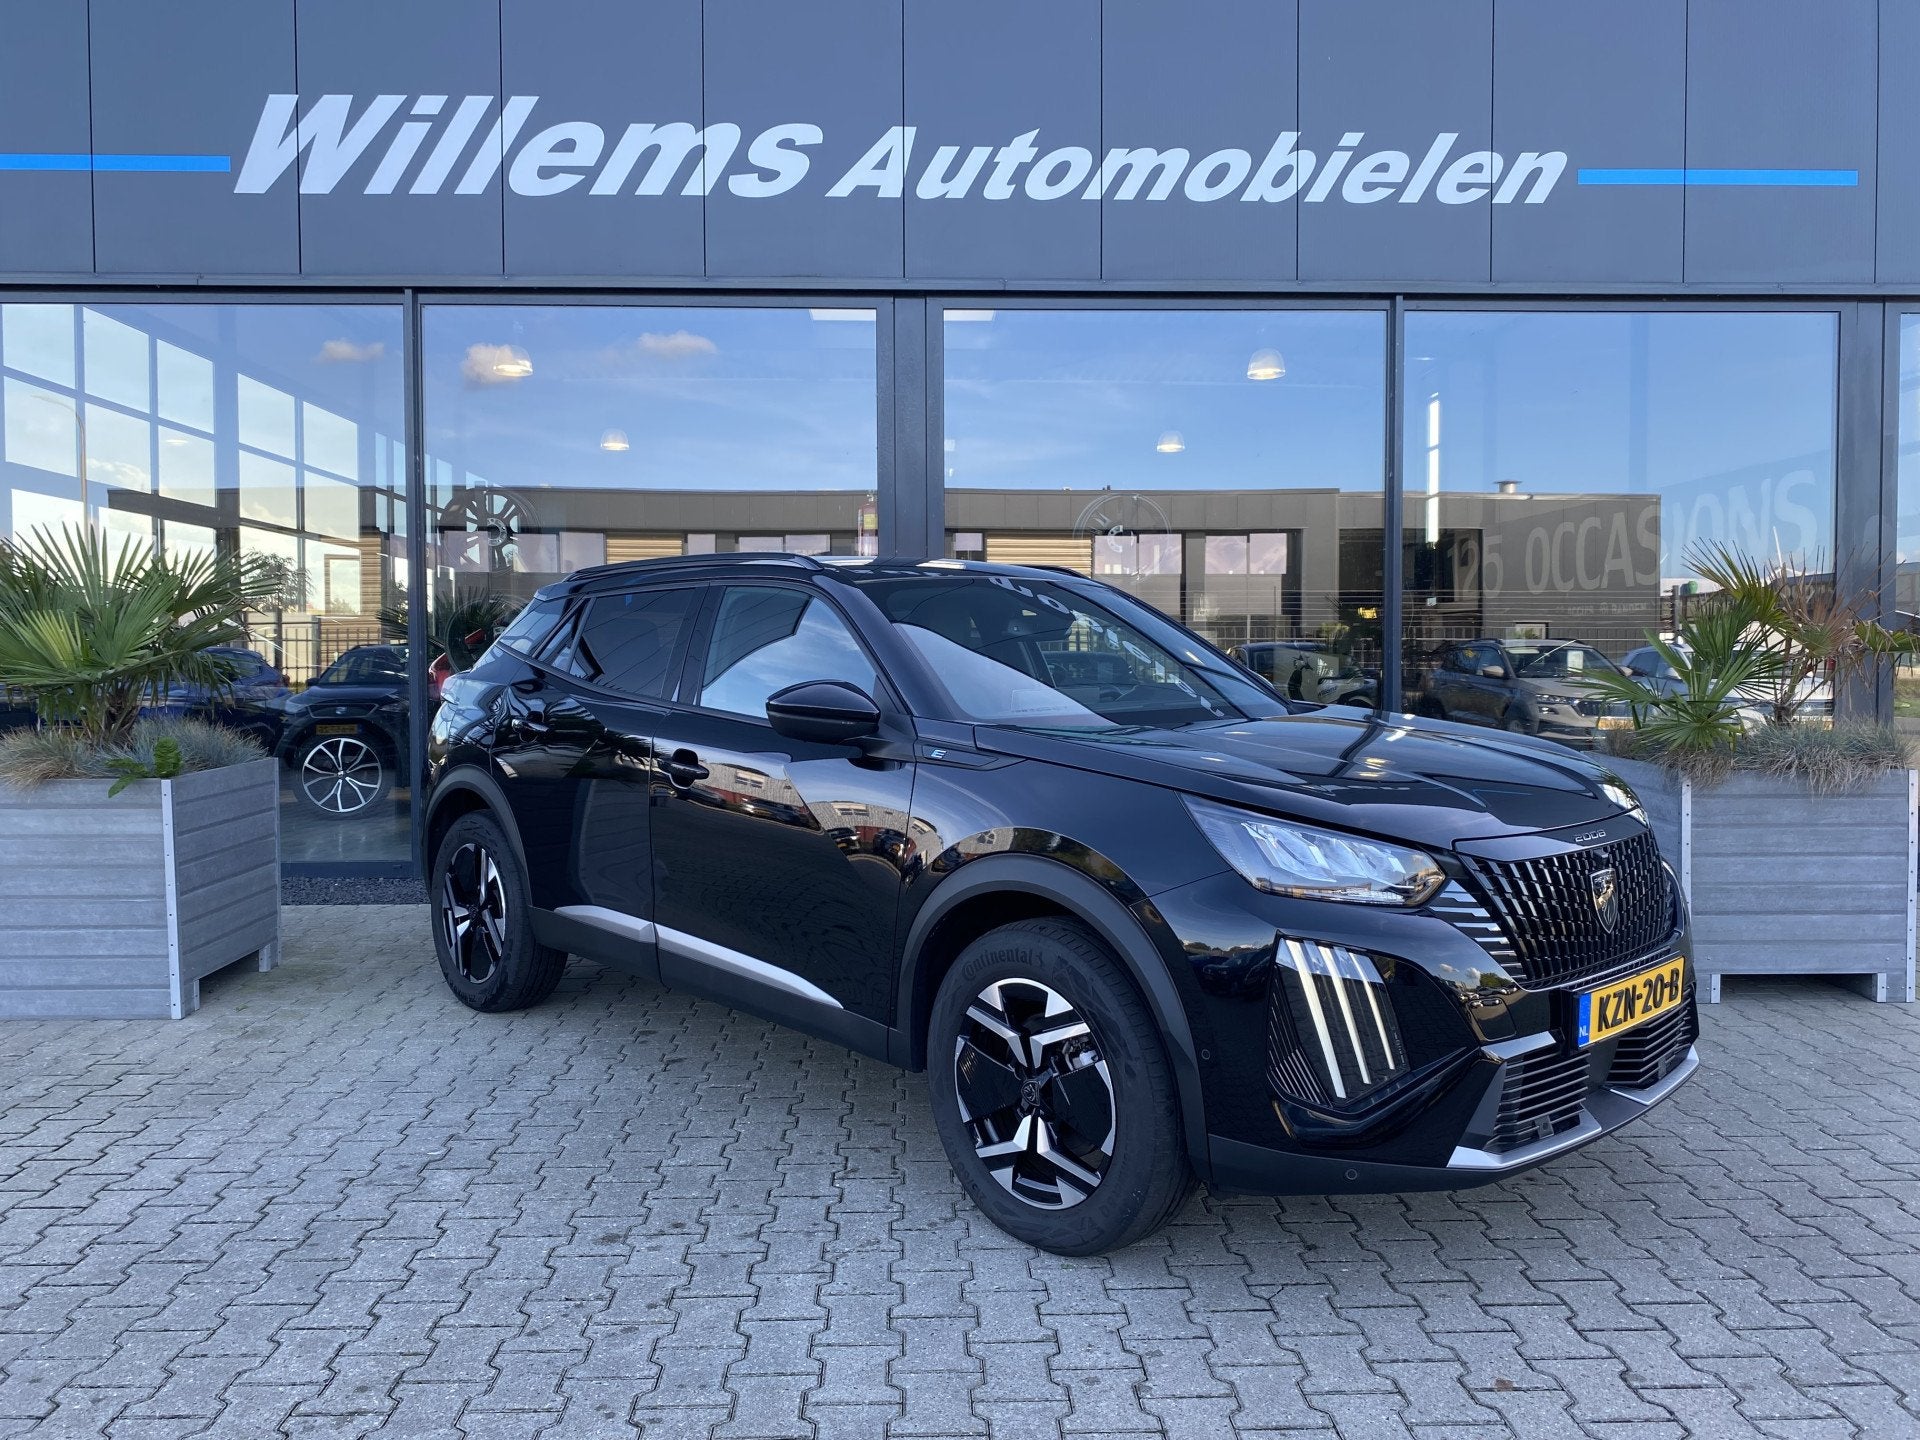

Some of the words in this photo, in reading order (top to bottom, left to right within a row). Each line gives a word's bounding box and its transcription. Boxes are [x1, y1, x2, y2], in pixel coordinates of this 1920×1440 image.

[234, 94, 823, 197] Willems
[825, 126, 1568, 204] Automobielen
[1525, 470, 1818, 595] OCCASIONS
[962, 947, 1033, 980] Continental
[1579, 1025, 1588, 1038] NL
[1598, 968, 1680, 1032] KZN-20-B
